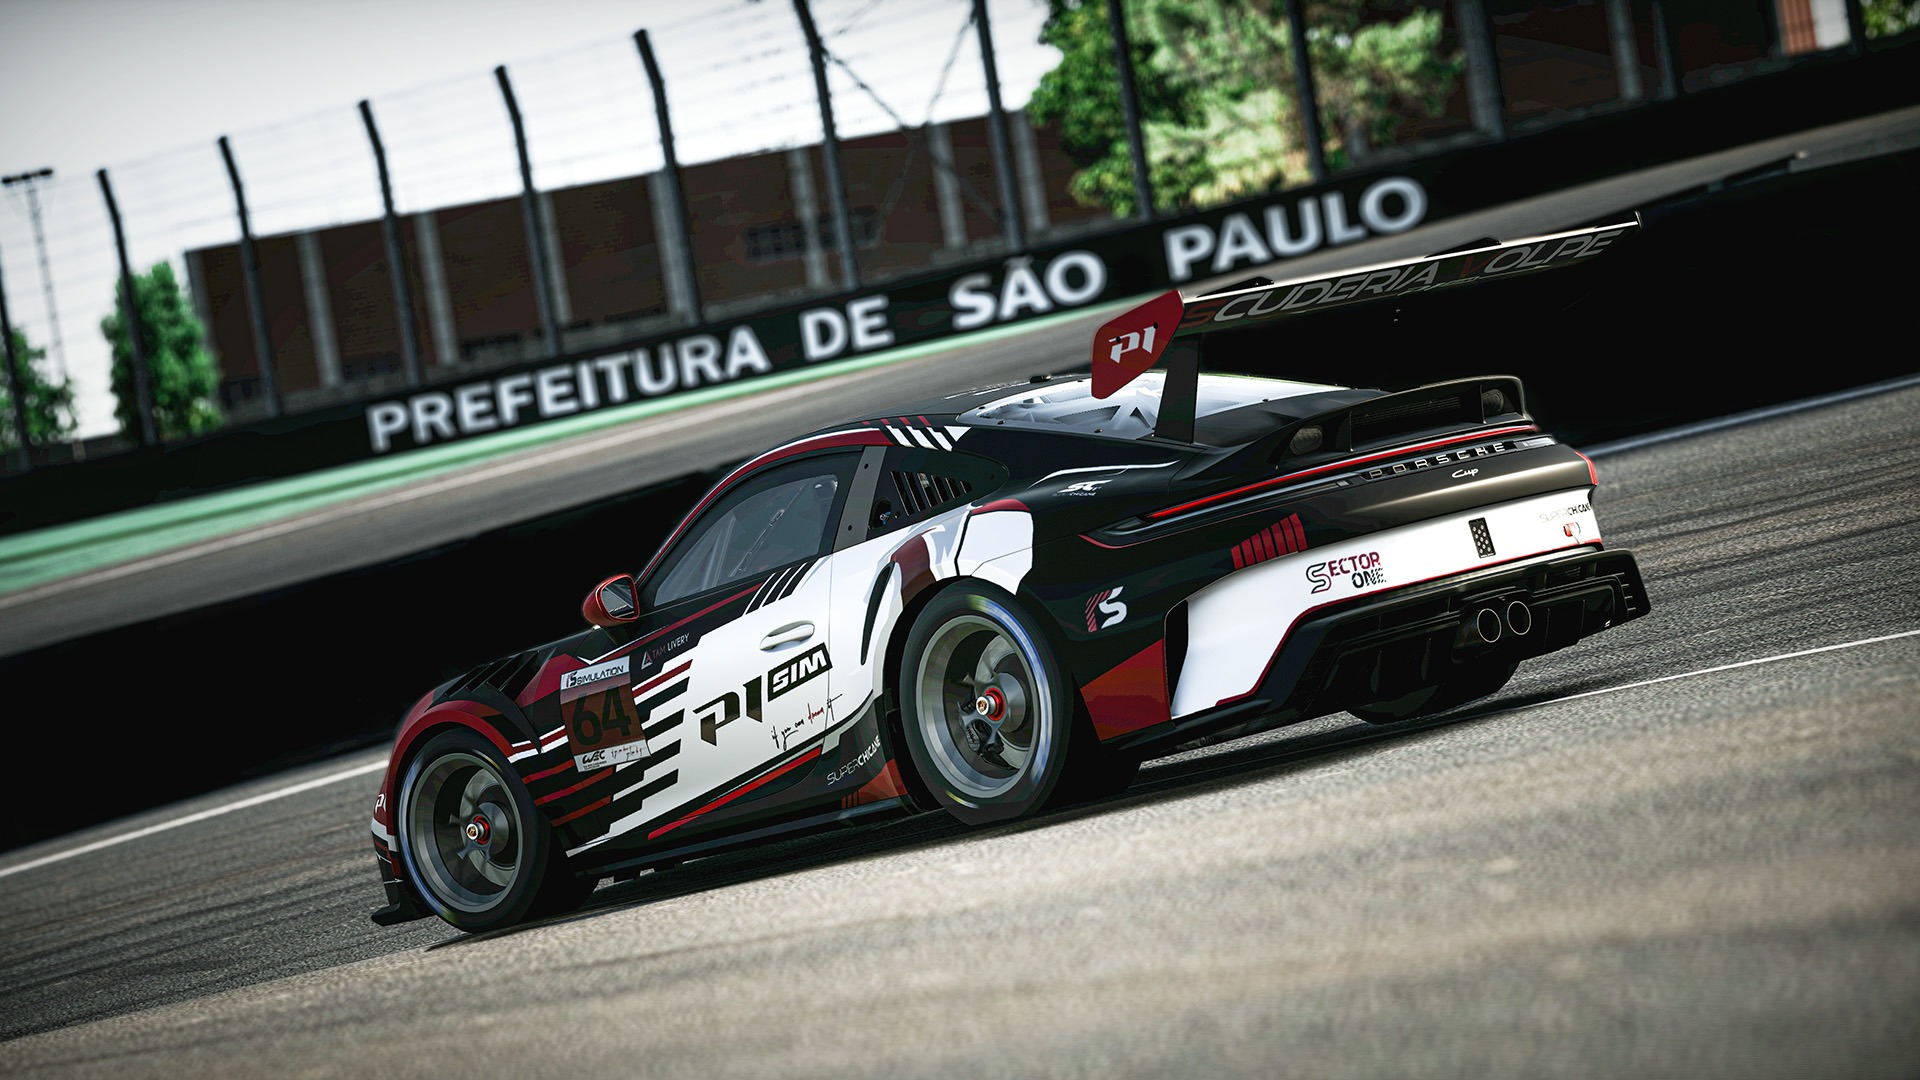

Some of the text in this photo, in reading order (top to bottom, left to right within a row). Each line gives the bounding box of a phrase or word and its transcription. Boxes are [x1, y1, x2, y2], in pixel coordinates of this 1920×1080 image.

[1179, 229, 1626, 329] SCUDERIA VOLPE
[366, 176, 1427, 452] PREFEITURA DE SÃO PAULO
[1368, 442, 1506, 479] PORSCHE
[1451, 467, 1479, 479] Cup
[1306, 551, 1381, 594] SECTOR
[667, 633, 690, 651] LIVERY
[772, 650, 828, 693] SIM
[572, 685, 632, 746] 64
[582, 749, 606, 764] WEC
[826, 734, 881, 786] SUPERCHICANE
